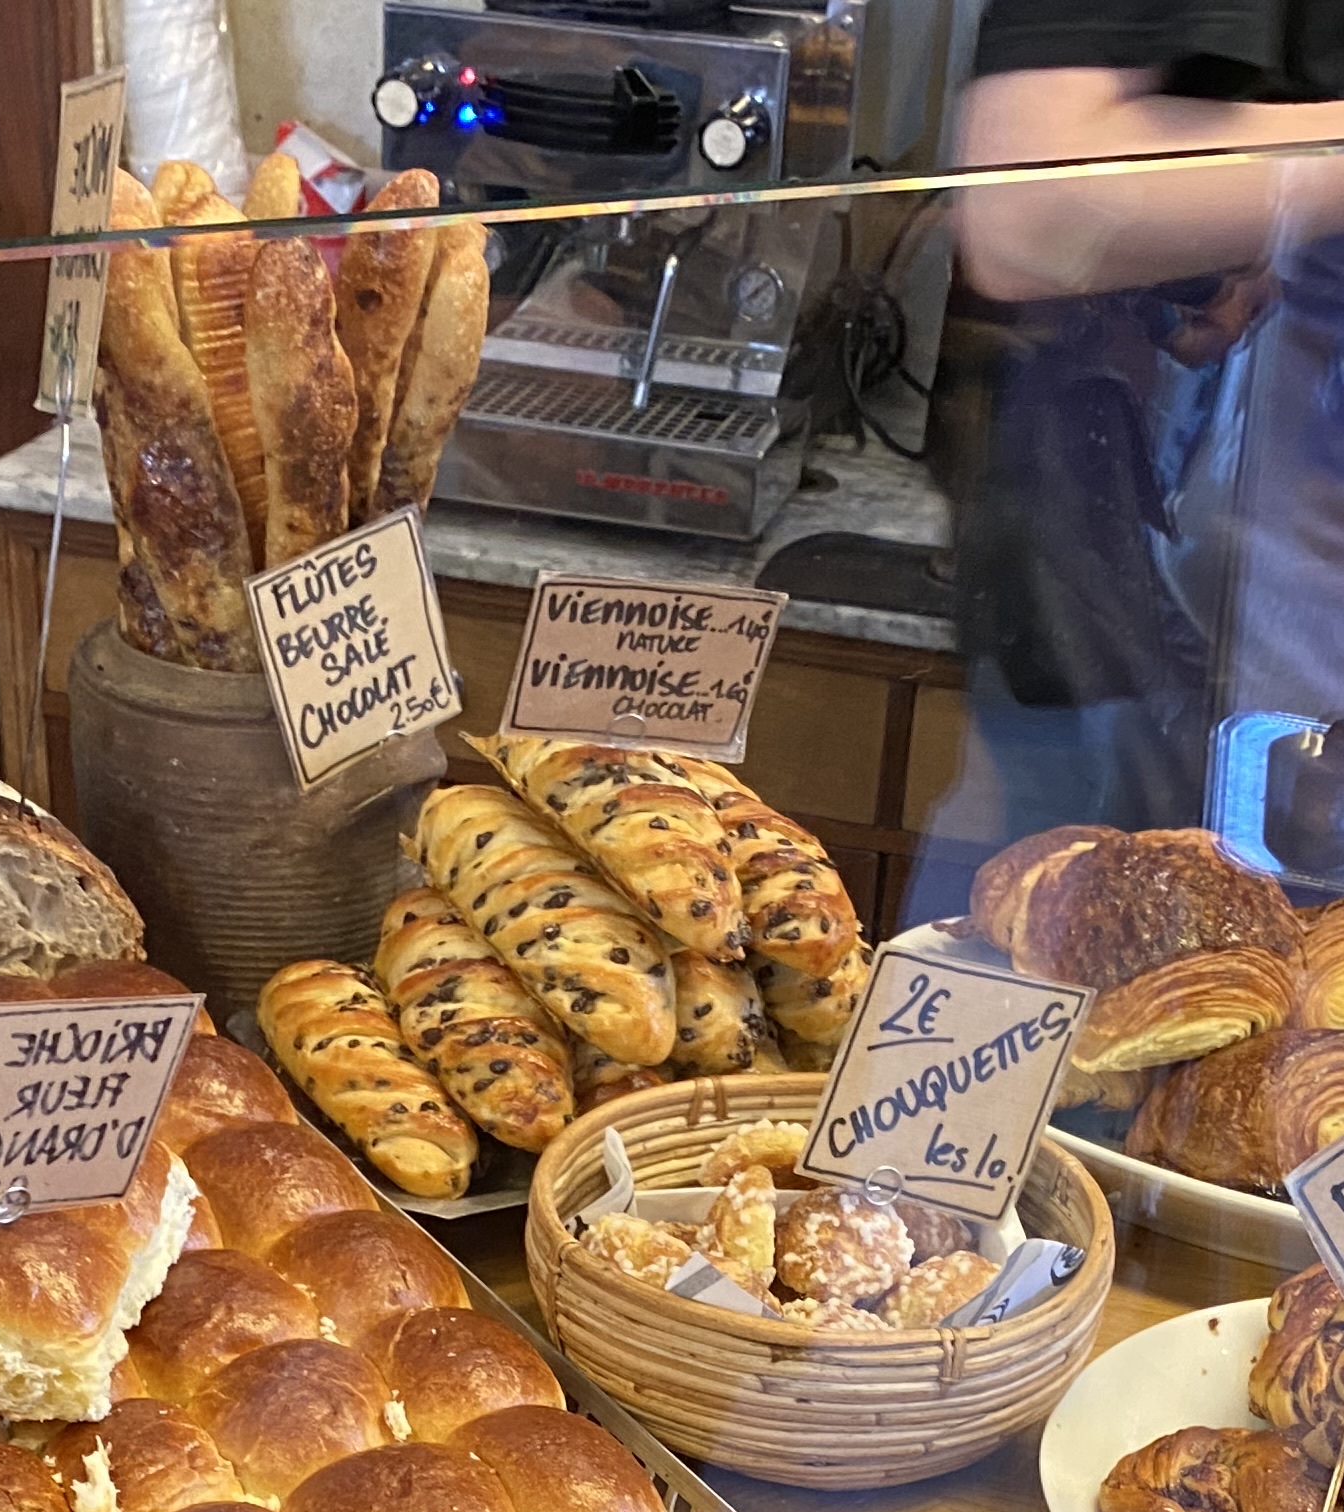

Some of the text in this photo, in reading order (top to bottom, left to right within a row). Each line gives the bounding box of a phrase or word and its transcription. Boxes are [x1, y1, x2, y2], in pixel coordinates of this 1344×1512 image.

[271, 544, 378, 618] FLÛTES
[276, 594, 378, 668] BEURRE
[299, 655, 416, 749] CHOCOLAT
[613, 696, 713, 722] CHOCOLAT
[879, 974, 951, 1035] 2€
[828, 1002, 1071, 1158] CHOUQUETTES
